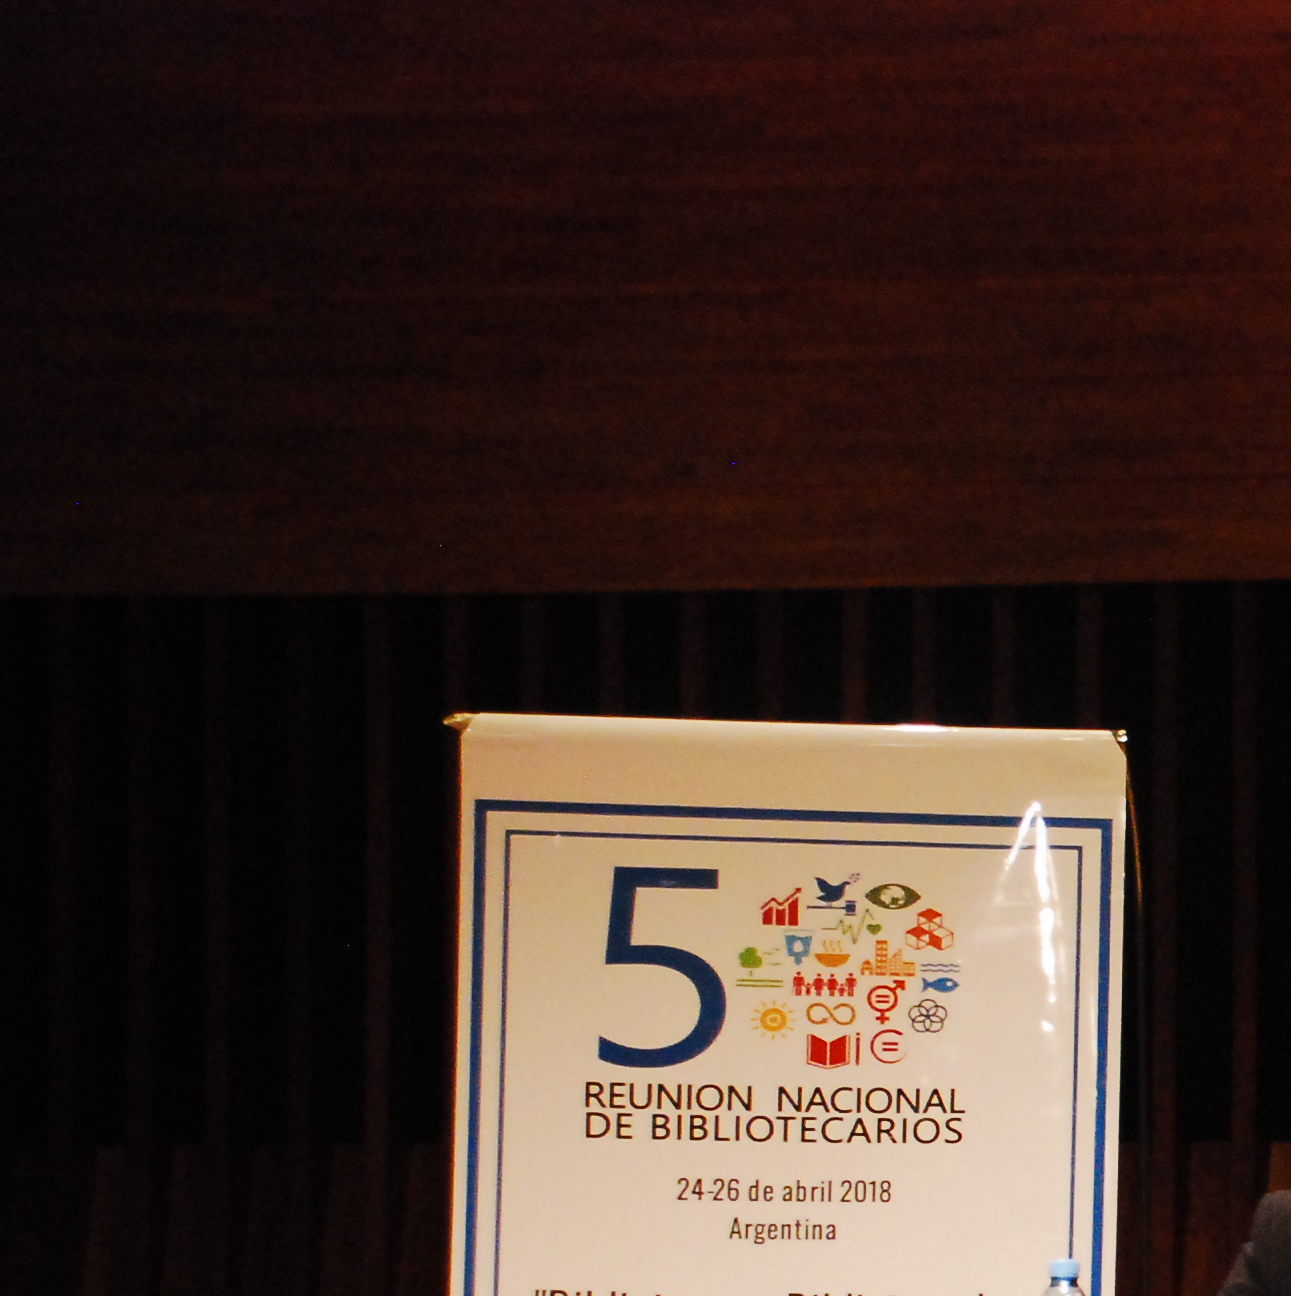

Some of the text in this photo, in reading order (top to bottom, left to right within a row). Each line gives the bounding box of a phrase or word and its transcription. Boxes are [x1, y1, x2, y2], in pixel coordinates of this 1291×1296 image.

[584, 1081, 967, 1116] REUNION NACIONAL
[585, 1111, 964, 1145] DE BIBLIOTECARIOS
[676, 1177, 892, 1204] 24-26 de abril 2018
[728, 1216, 838, 1245] Argentina
